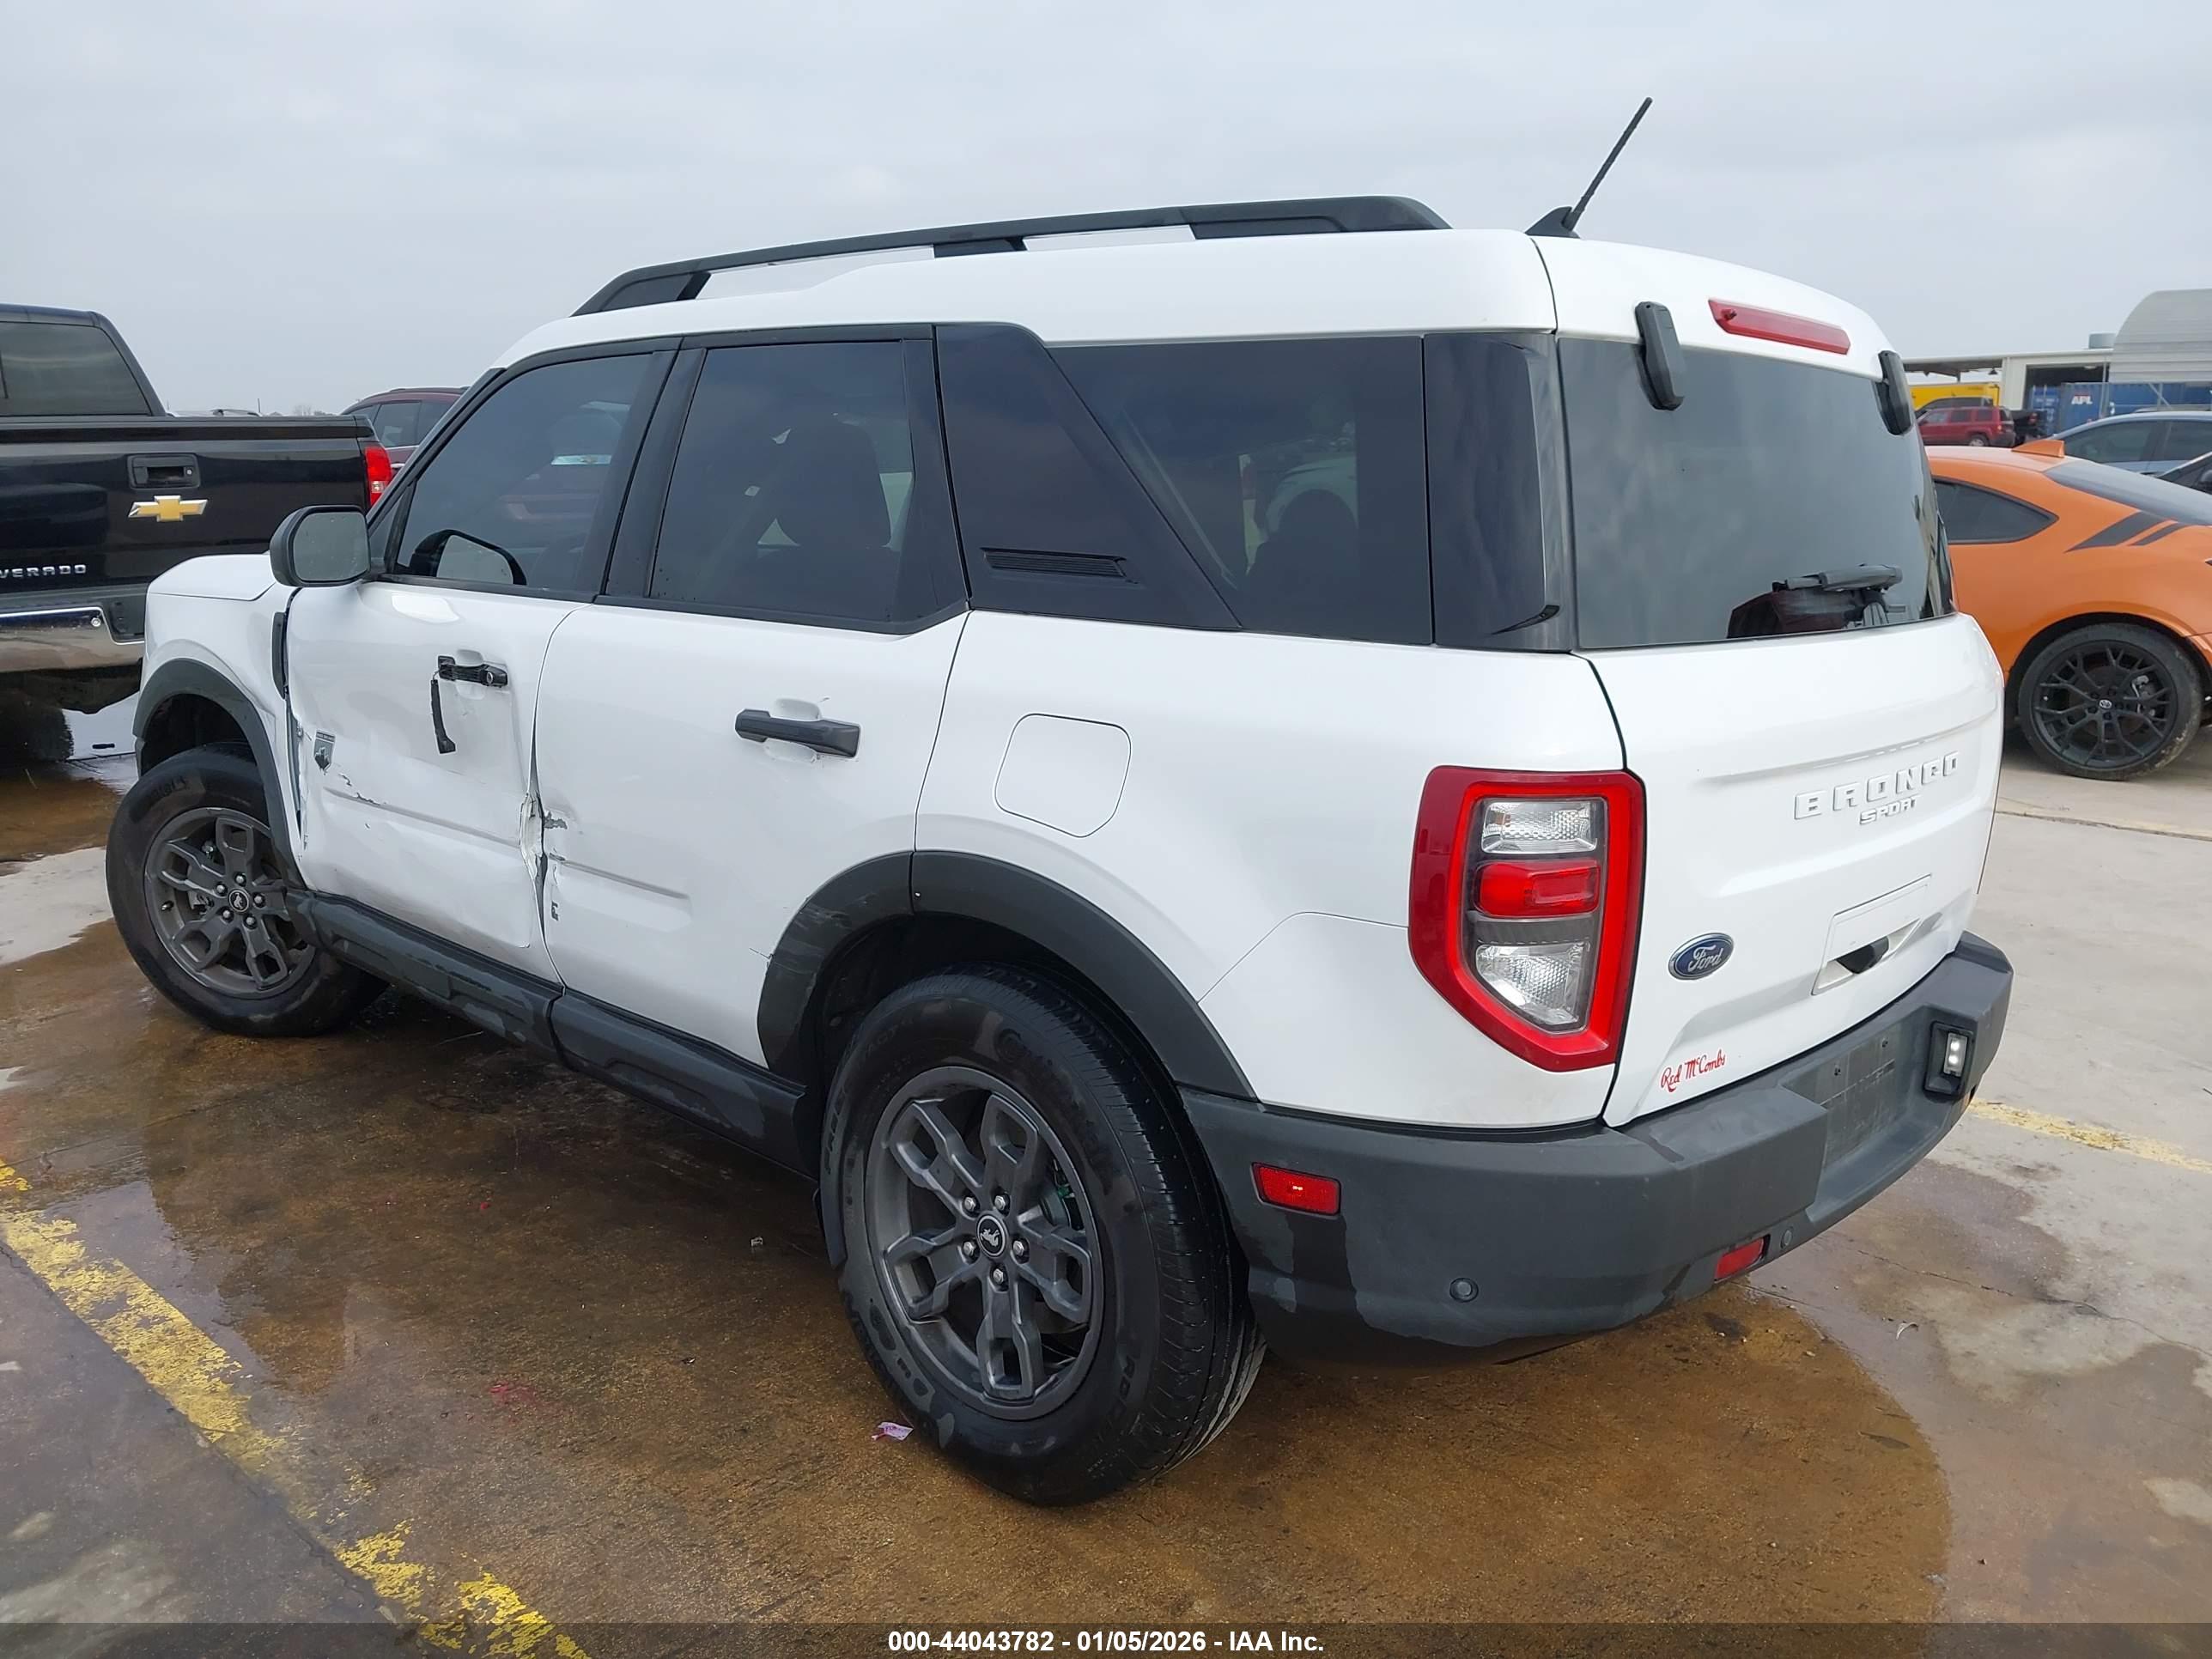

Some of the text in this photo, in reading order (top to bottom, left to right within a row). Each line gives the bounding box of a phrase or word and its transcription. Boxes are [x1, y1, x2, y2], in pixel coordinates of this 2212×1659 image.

[2071, 395, 2094, 405] APL
[1794, 750, 1960, 820] BRONCO
[1859, 793, 1922, 825] SPORT
[1687, 944, 1724, 973] Ford
[1661, 1063, 1683, 1093] Red
